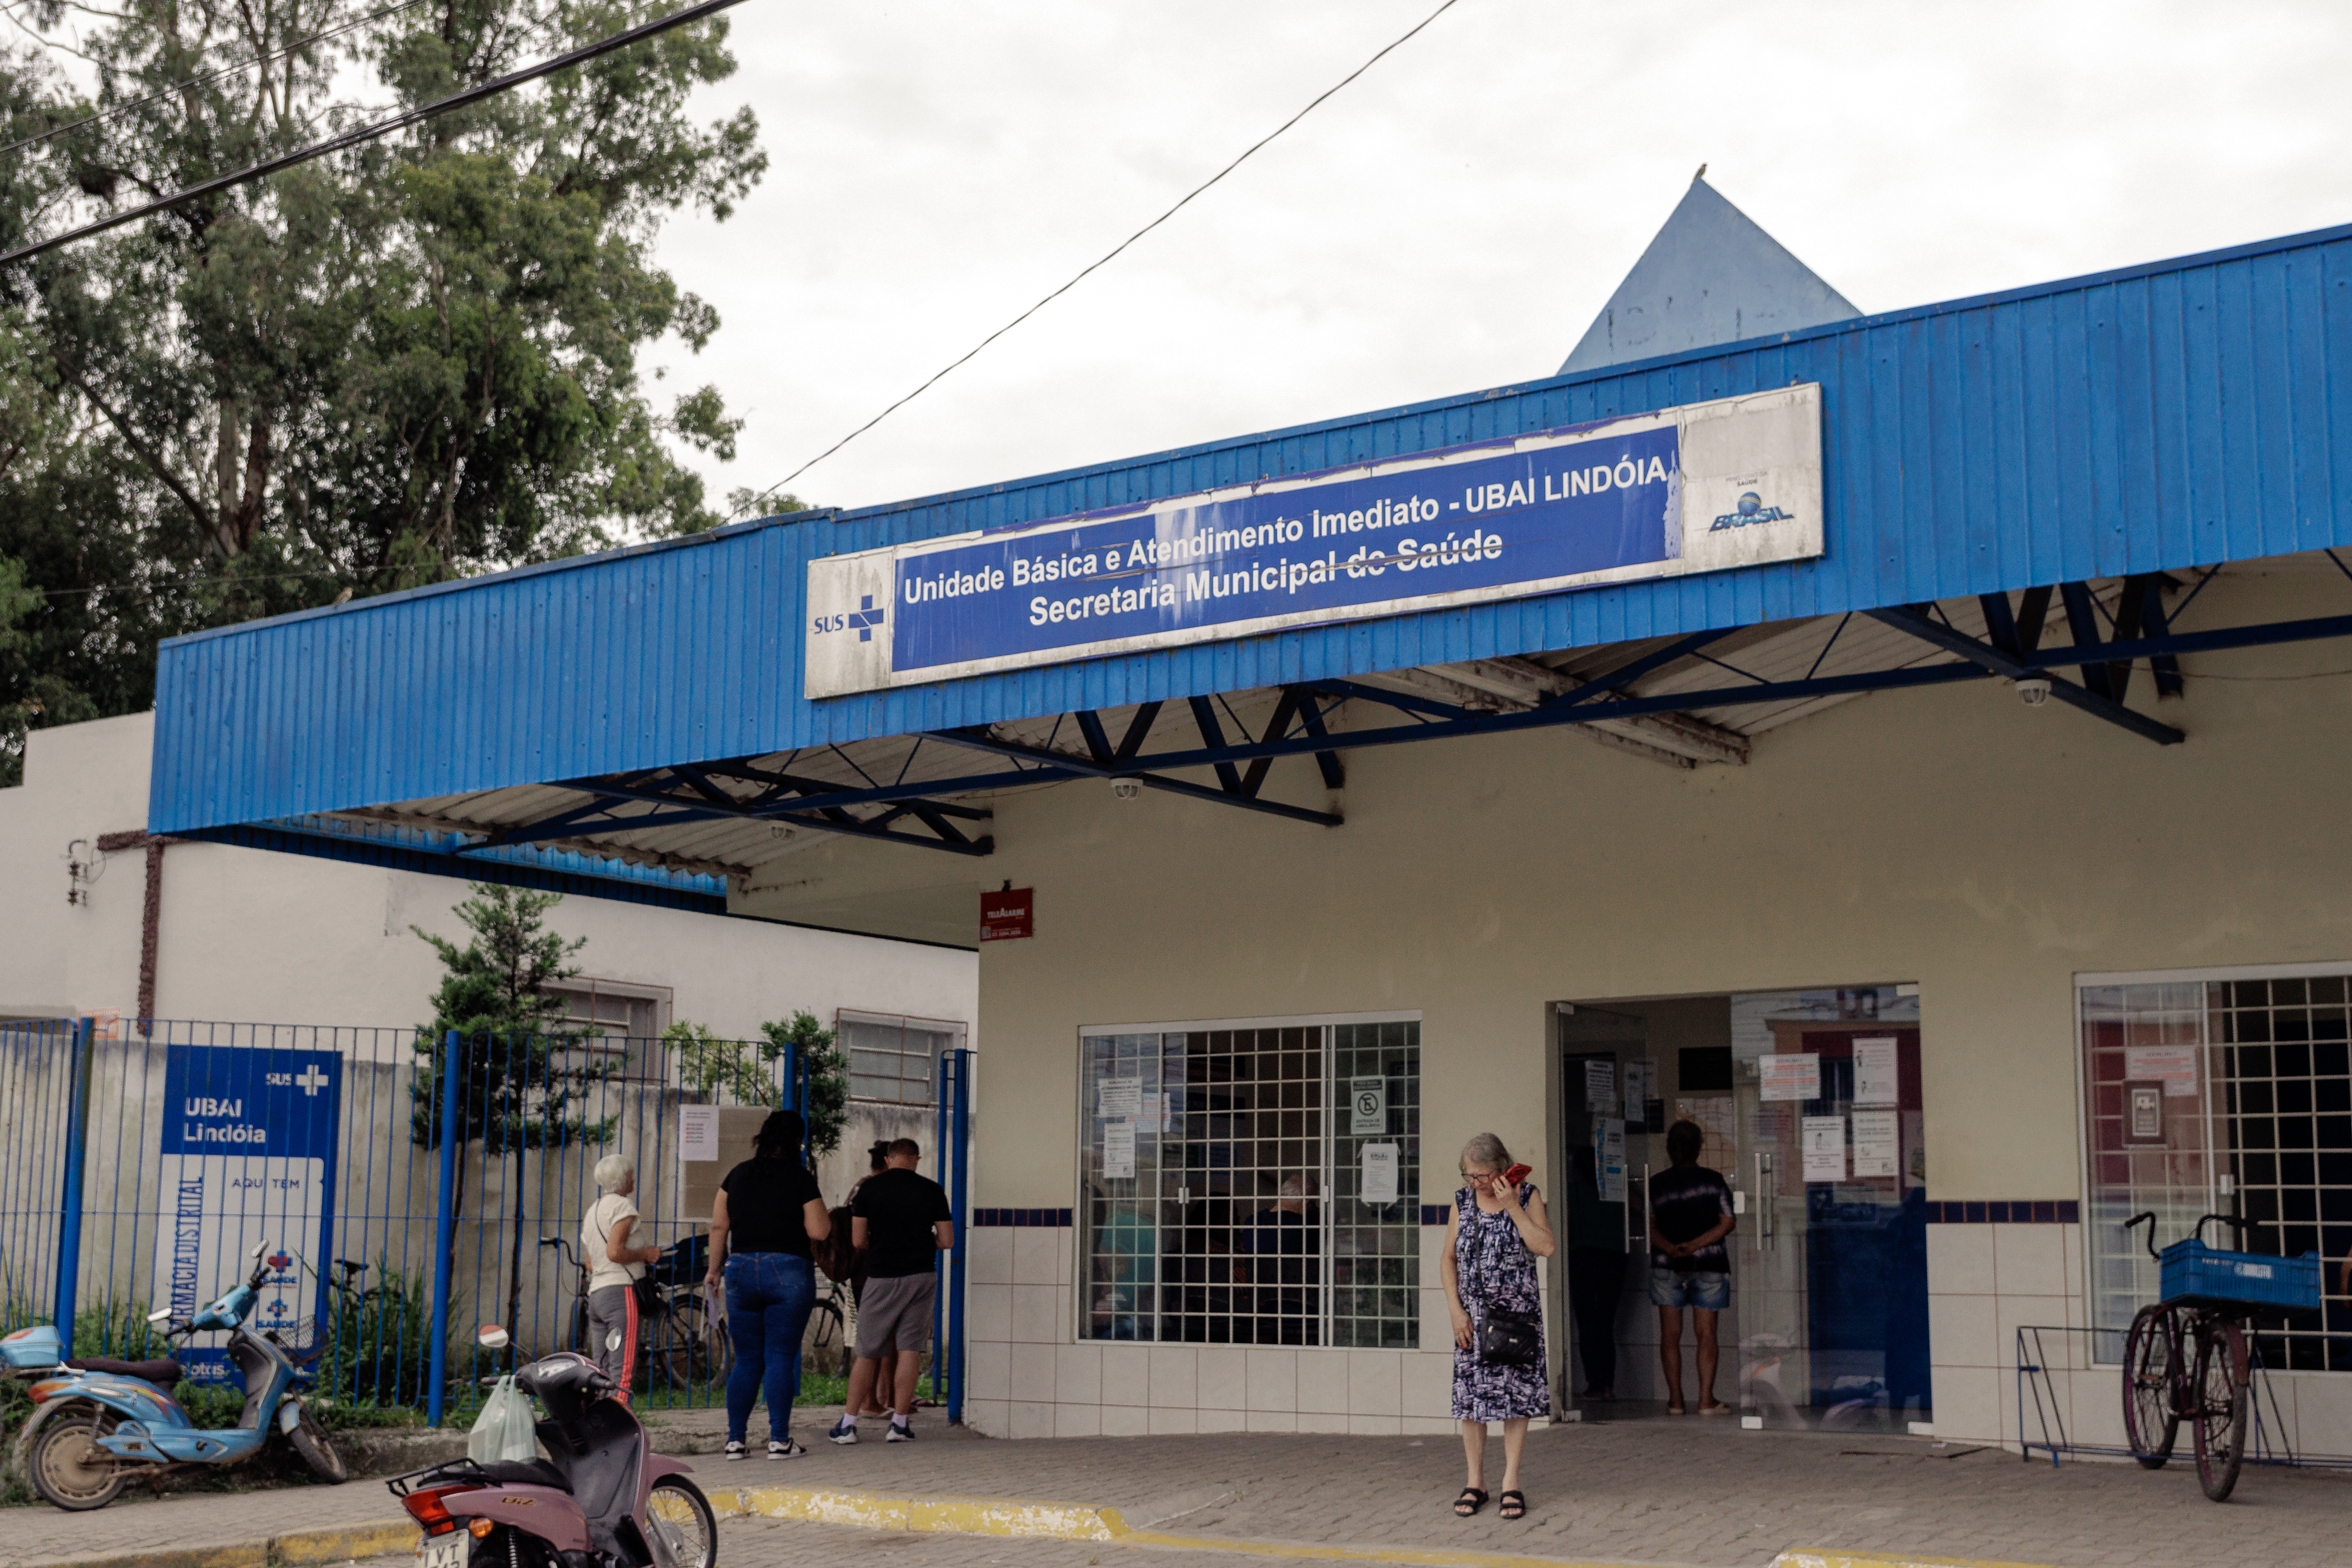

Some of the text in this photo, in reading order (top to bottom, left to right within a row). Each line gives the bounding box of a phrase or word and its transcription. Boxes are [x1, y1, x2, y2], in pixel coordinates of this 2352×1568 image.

[905, 454, 1668, 604] Unidade Básica e Atendimento Imediato - UBAI LINDÓIA
[1709, 506, 1795, 532] BRASIL
[1029, 529, 1503, 626] Secretaria Municipal de Saúde
[814, 613, 843, 634] SUS
[265, 1072, 292, 1086] SUS
[185, 1097, 242, 1117] UBAI
[183, 1122, 266, 1144] Lindóia
[232, 1178, 300, 1188] AQU TEM
[425, 1543, 459, 1567] IVT
